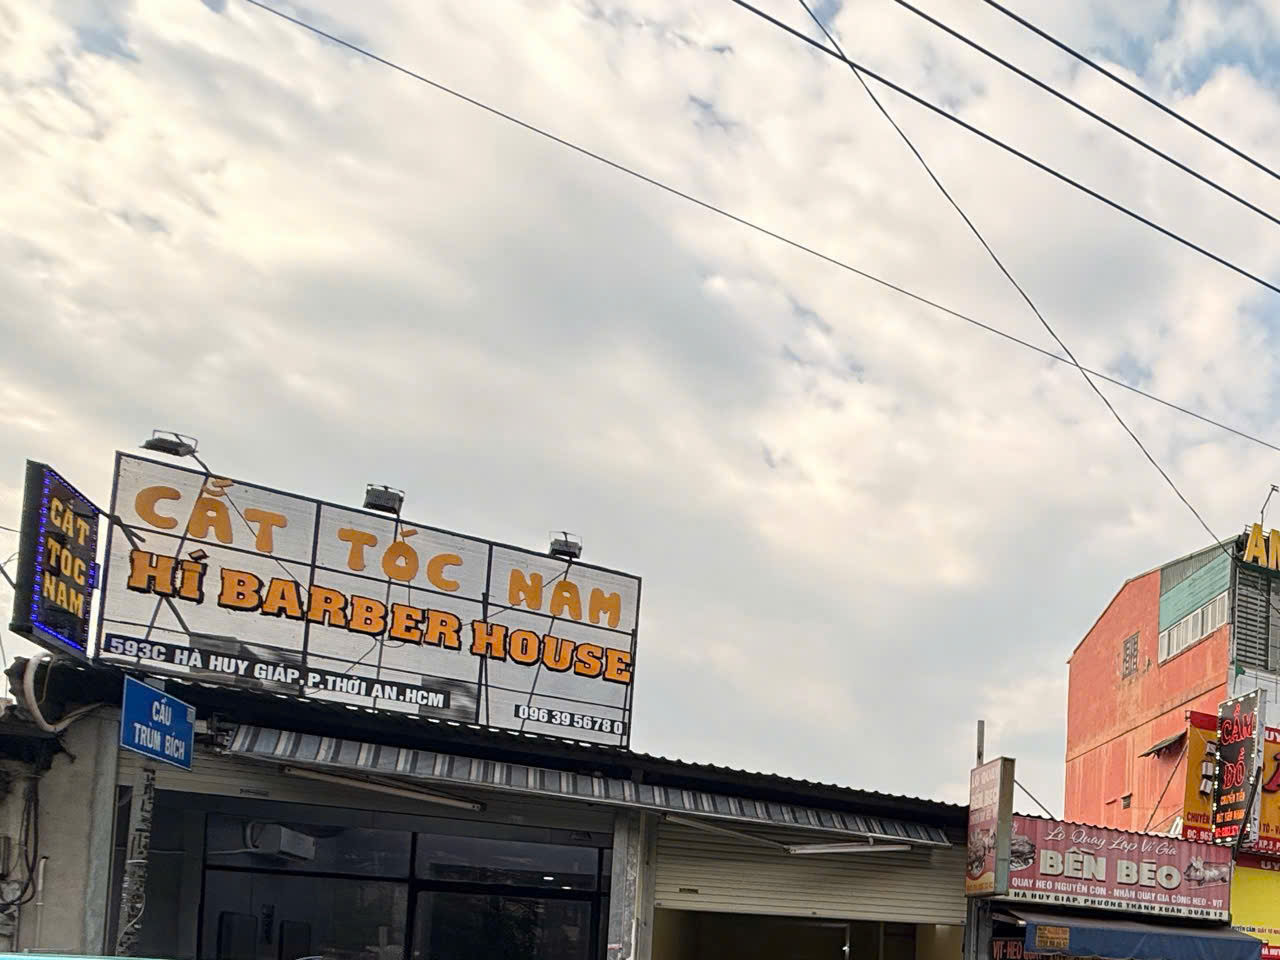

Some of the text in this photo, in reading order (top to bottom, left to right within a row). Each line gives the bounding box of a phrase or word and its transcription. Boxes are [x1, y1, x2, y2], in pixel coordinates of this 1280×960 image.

[42, 570, 84, 619] NAM
[338, 527, 464, 592] TÓC
[509, 569, 621, 628] NAM
[127, 549, 634, 683] HÍ BARBER HOUSE
[110, 636, 166, 661] 593C
[174, 647, 203, 668] HÀ
[209, 655, 248, 676] HUY
[519, 705, 549, 723] 096
[552, 711, 571, 726] 39
[165, 731, 185, 760] BÍCH
[1072, 828, 1177, 856] Quay Gia
[1012, 877, 1034, 888] QUAY
[1036, 880, 1053, 890] HEO
[1054, 881, 1088, 893] NGUYÊN
[1089, 885, 1107, 895] CON
